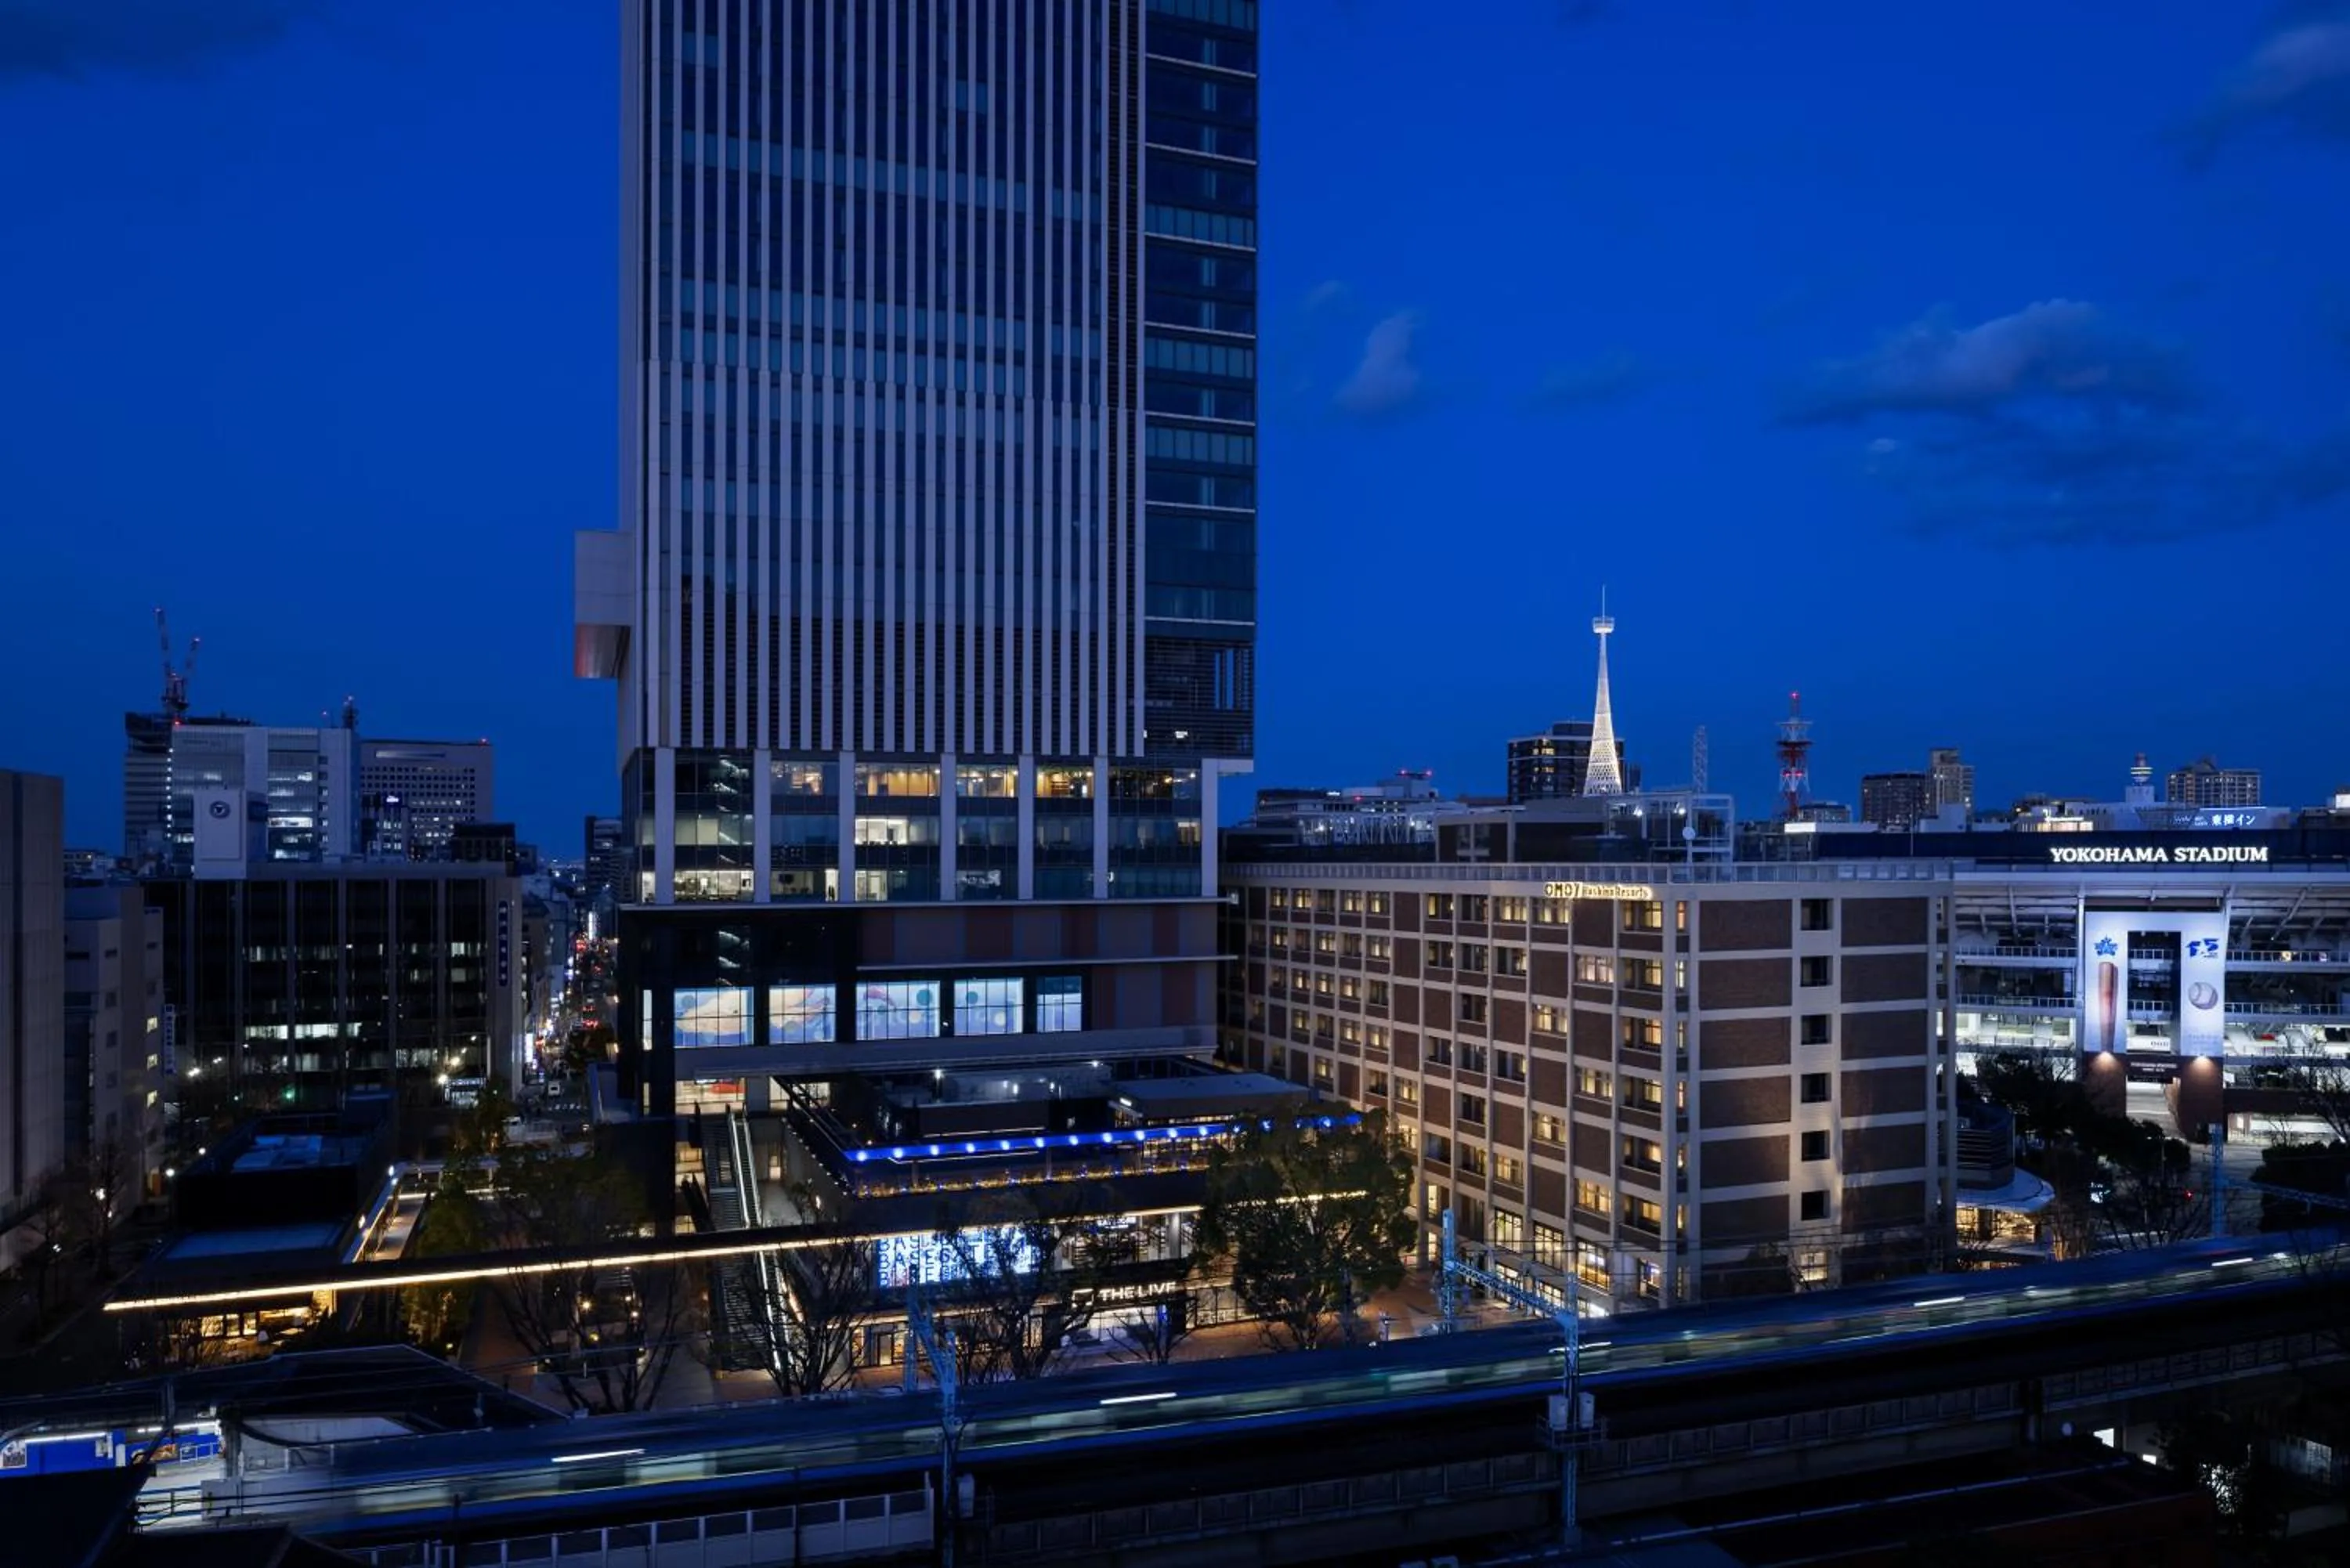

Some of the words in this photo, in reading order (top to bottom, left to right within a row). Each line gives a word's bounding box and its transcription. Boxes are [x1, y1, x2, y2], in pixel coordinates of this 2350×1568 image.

[2049, 847, 2168, 862] YOKOHAMA
[2174, 847, 2269, 862] STADIUM
[1098, 1285, 1135, 1302] THE
